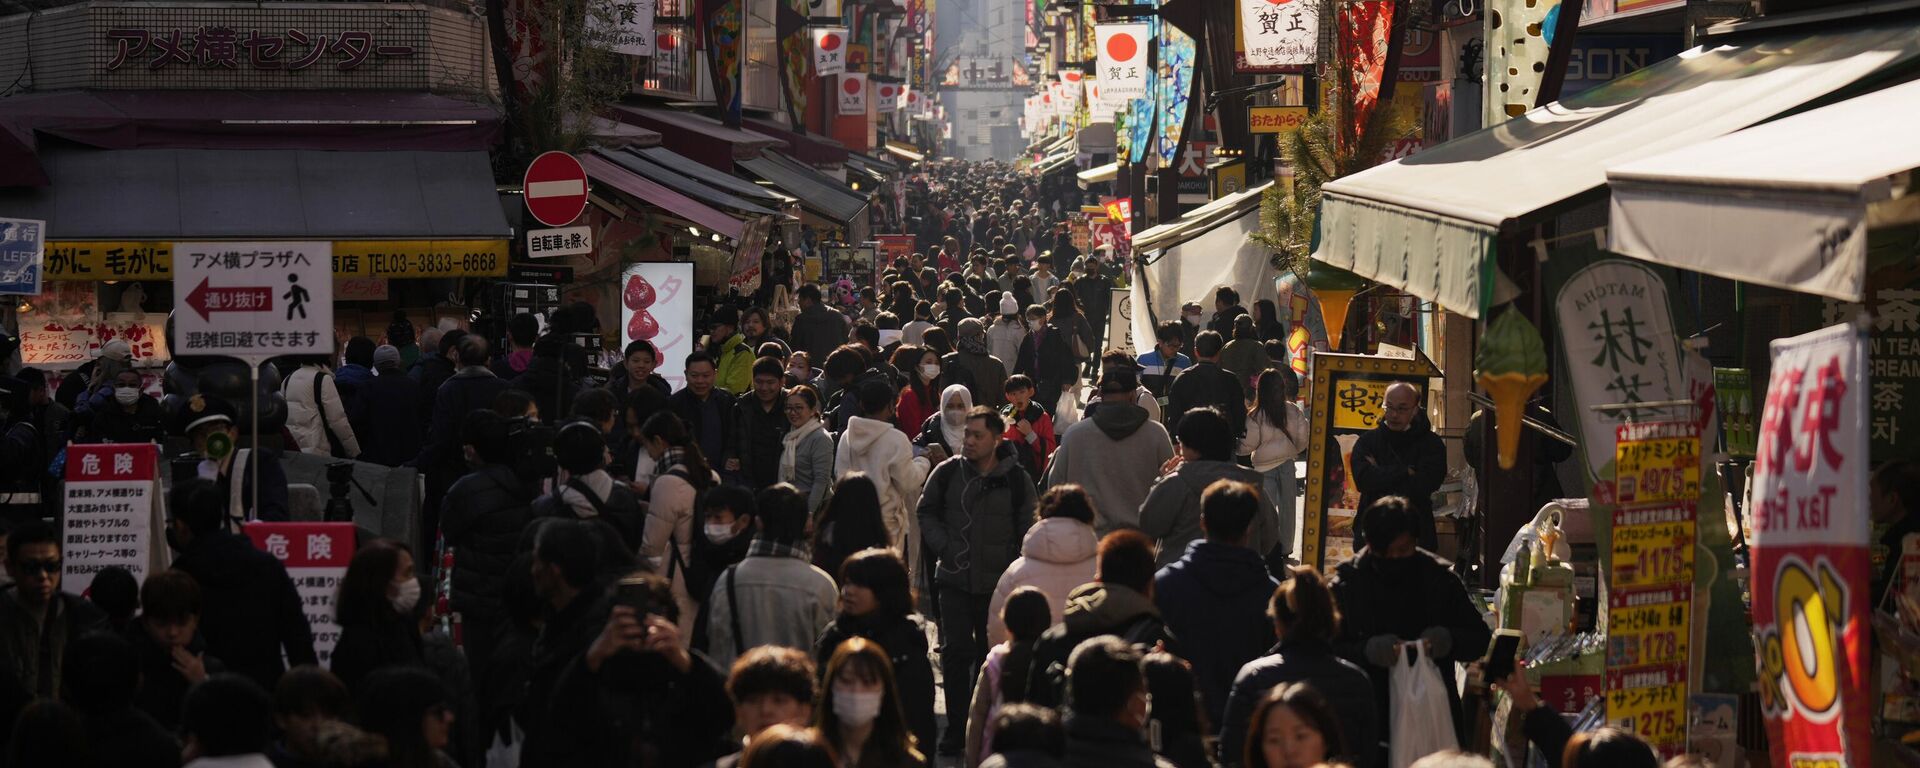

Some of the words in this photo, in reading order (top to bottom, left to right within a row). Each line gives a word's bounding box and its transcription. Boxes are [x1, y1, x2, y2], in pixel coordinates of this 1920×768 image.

[1258, 12, 1307, 35] 賀正
[107, 27, 413, 71] アメ横センター
[1109, 66, 1139, 80] 賀正
[531, 233, 589, 252] 自転車を除く
[4, 251, 36, 262] LEFT
[42, 248, 91, 274] がに
[105, 248, 168, 275] 毛がに
[190, 251, 311, 269] アメ横プラザへ
[368, 253, 496, 273] TEL03-3833-6668
[204, 292, 267, 308] 通り抜け
[186, 331, 320, 349] 混雑回避できます
[1340, 384, 1383, 412] 串か
[1873, 381, 1904, 411] 茶
[1872, 416, 1900, 445] 차
[1619, 440, 1693, 461] アリナミンEX
[81, 453, 134, 475] 危険
[69, 489, 143, 498] 歳末時、アメ横通りは
[68, 504, 134, 513] 大変混み合います。
[68, 519, 130, 528] 事故やトラブルの
[67, 534, 137, 543] 原因となりますので
[265, 533, 333, 560] 危険
[67, 549, 137, 558] キャリーケース等の
[1611, 687, 1677, 709] サンテFX
